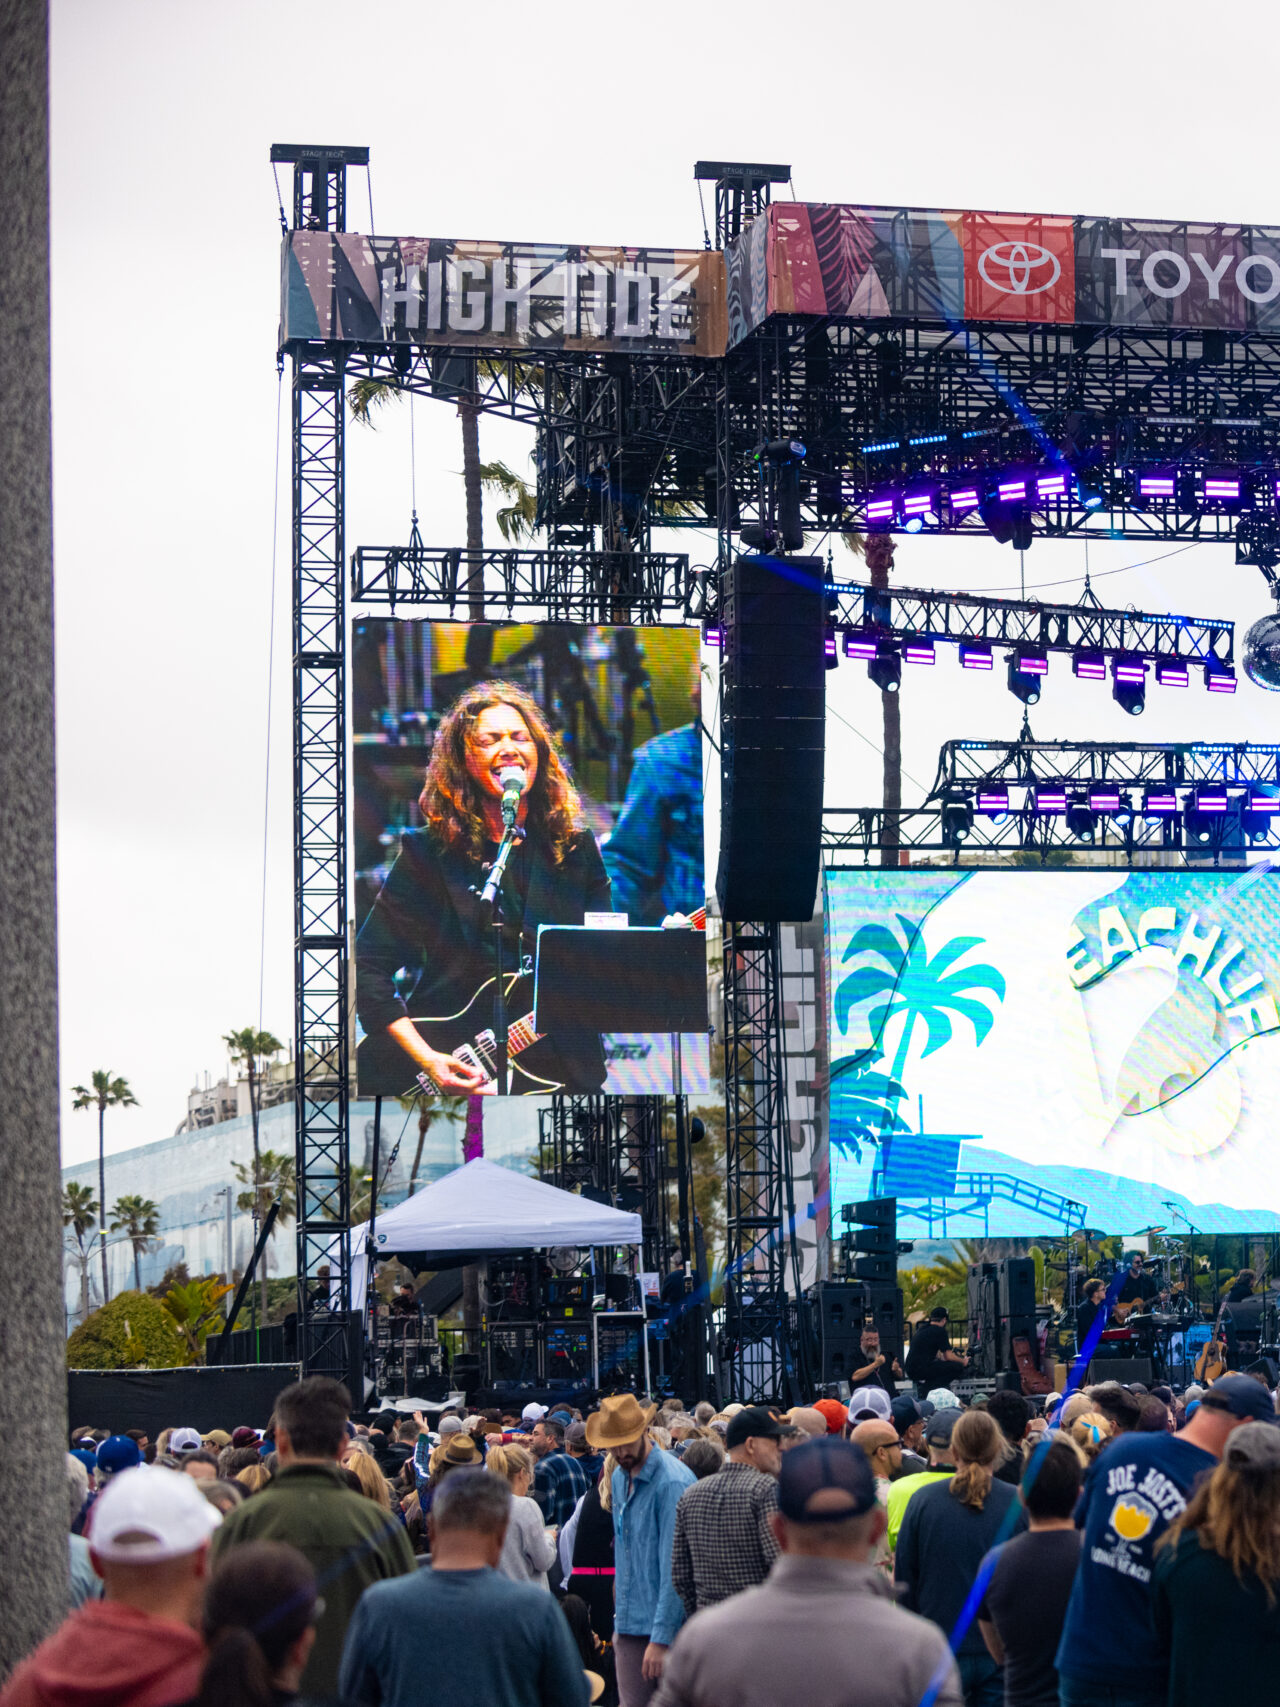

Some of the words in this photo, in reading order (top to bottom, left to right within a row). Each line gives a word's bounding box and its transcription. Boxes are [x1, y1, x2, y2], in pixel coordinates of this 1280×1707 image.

[381, 257, 531, 335] HIGH
[553, 261, 692, 340] TIDE
[1106, 1463, 1138, 1496] JOE
